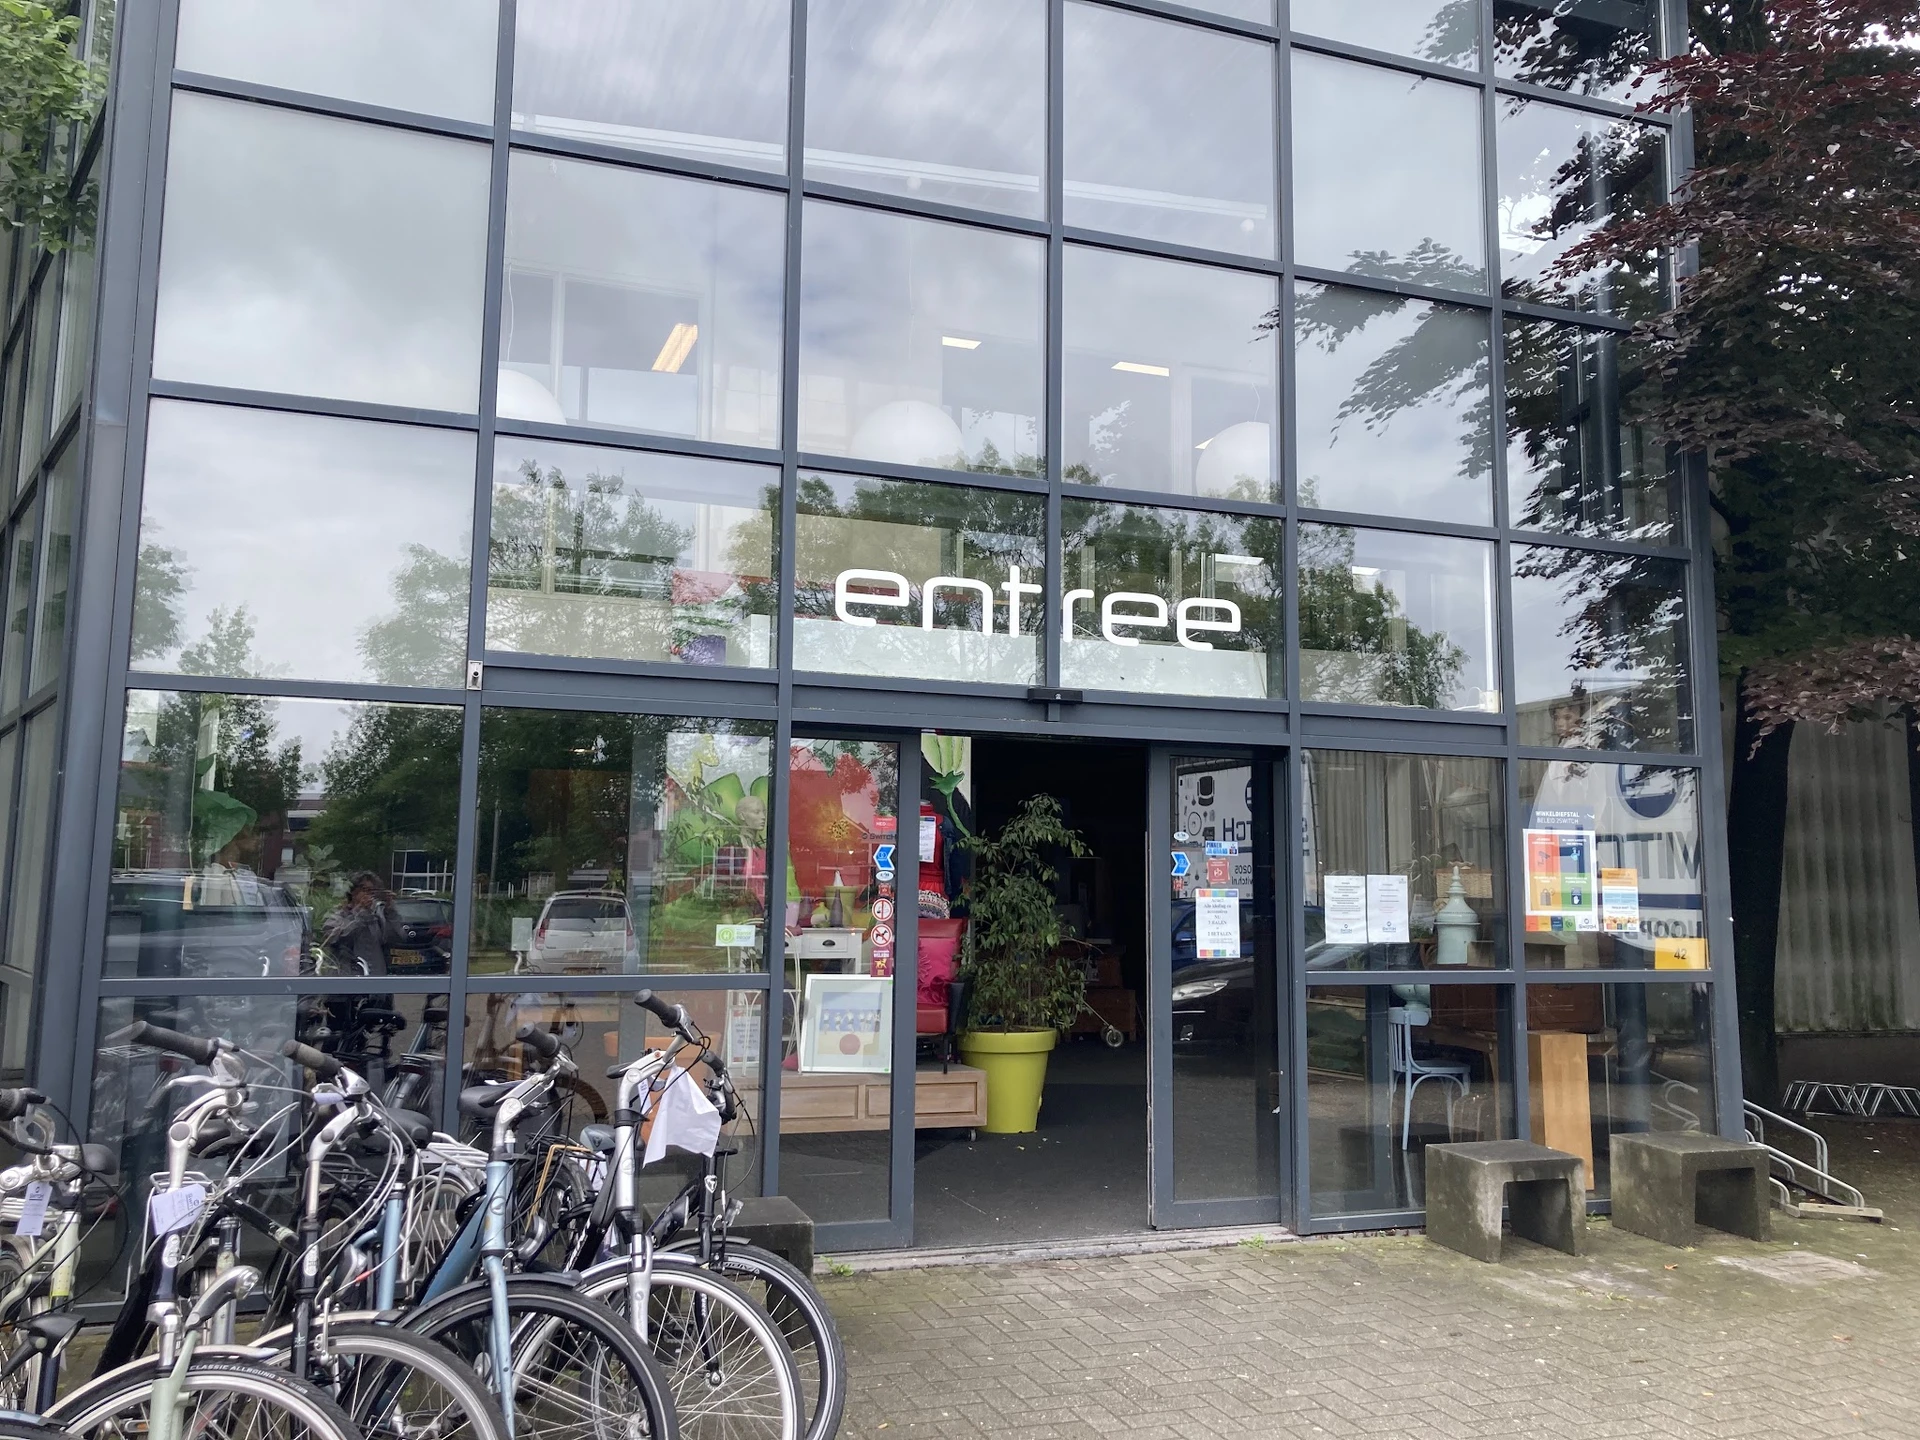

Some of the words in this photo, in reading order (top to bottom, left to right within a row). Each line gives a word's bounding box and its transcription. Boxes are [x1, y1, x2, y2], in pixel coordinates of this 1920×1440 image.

[834, 564, 1242, 652] entree
[1535, 810, 1580, 818] WINKELDIEFSTAL
[1673, 948, 1688, 960] 42
[229, 1365, 276, 1380] ALLROUND
